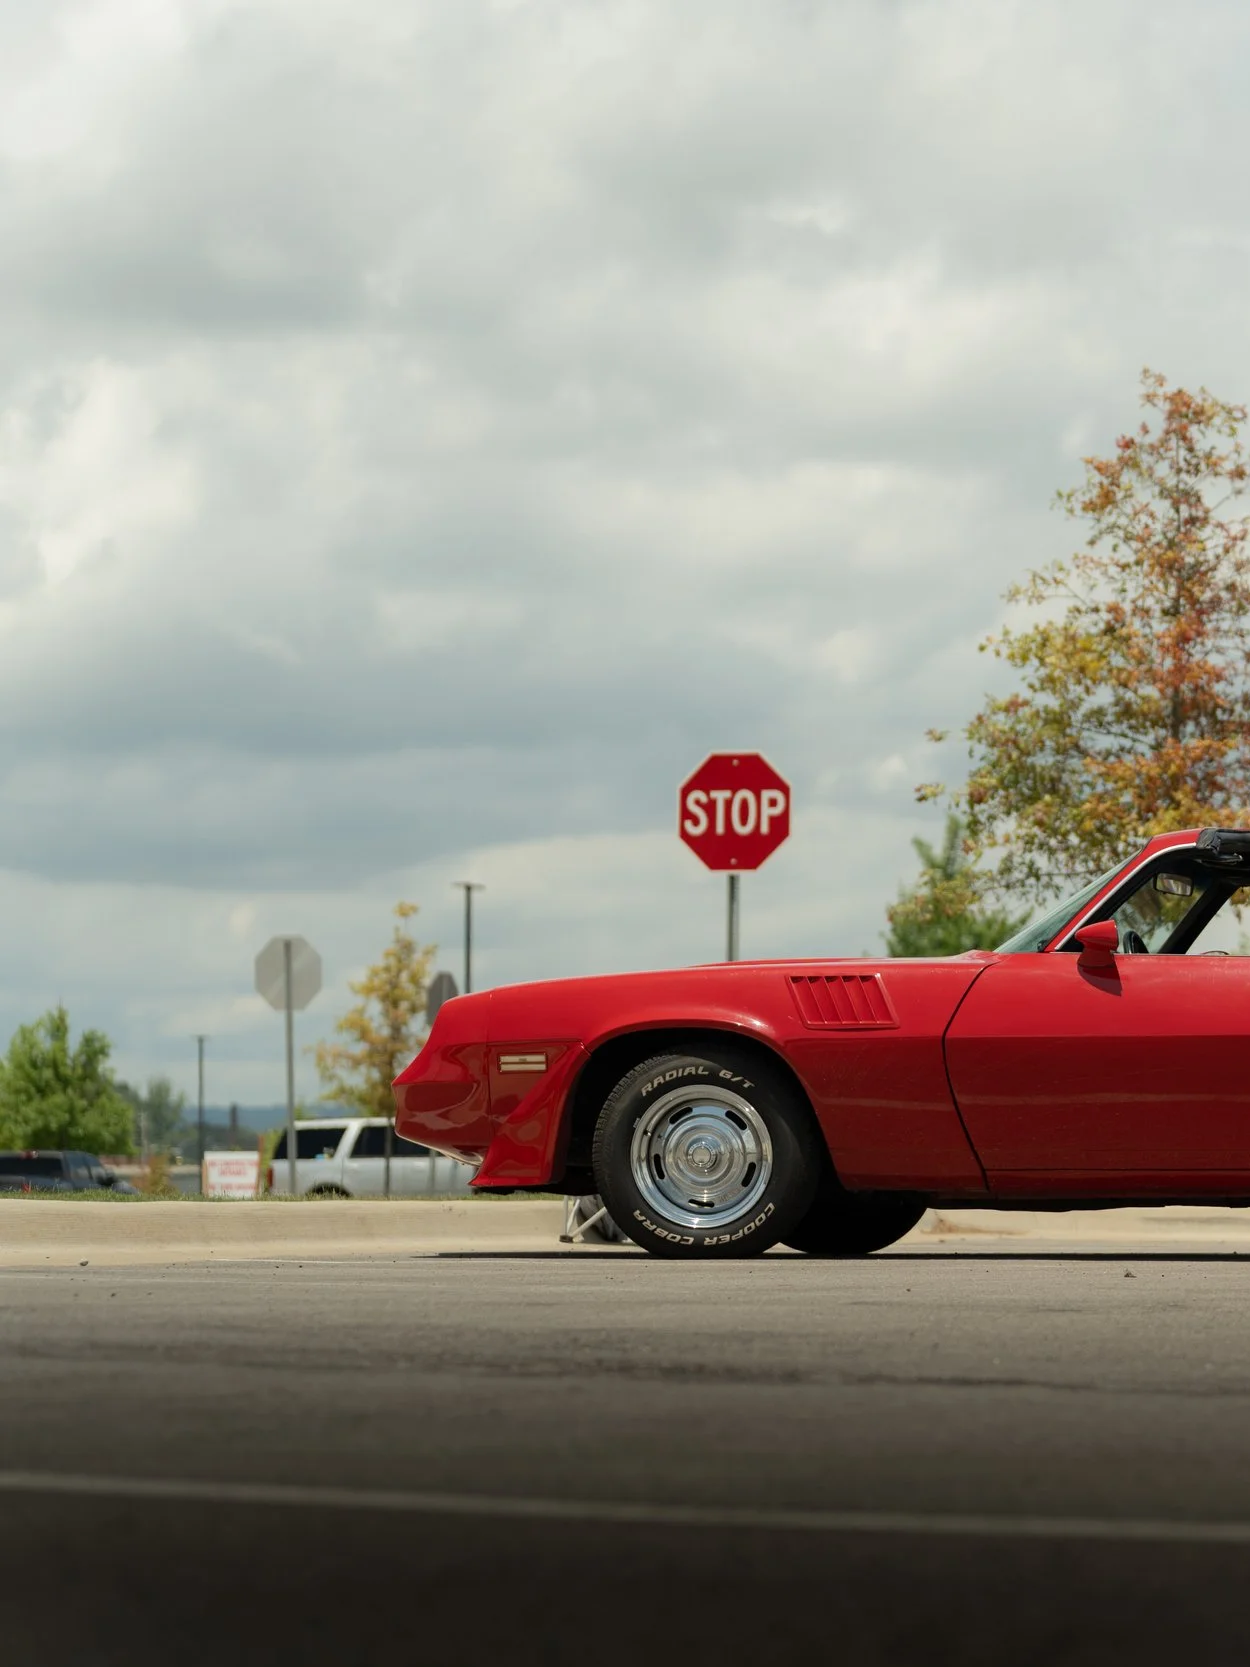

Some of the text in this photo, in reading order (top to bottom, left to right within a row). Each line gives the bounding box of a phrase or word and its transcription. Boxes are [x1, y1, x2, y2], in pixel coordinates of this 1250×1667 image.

[684, 789, 785, 836] STOP
[641, 1066, 755, 1097] RADIAL G/T
[632, 1203, 776, 1246] COOPER COBRA
